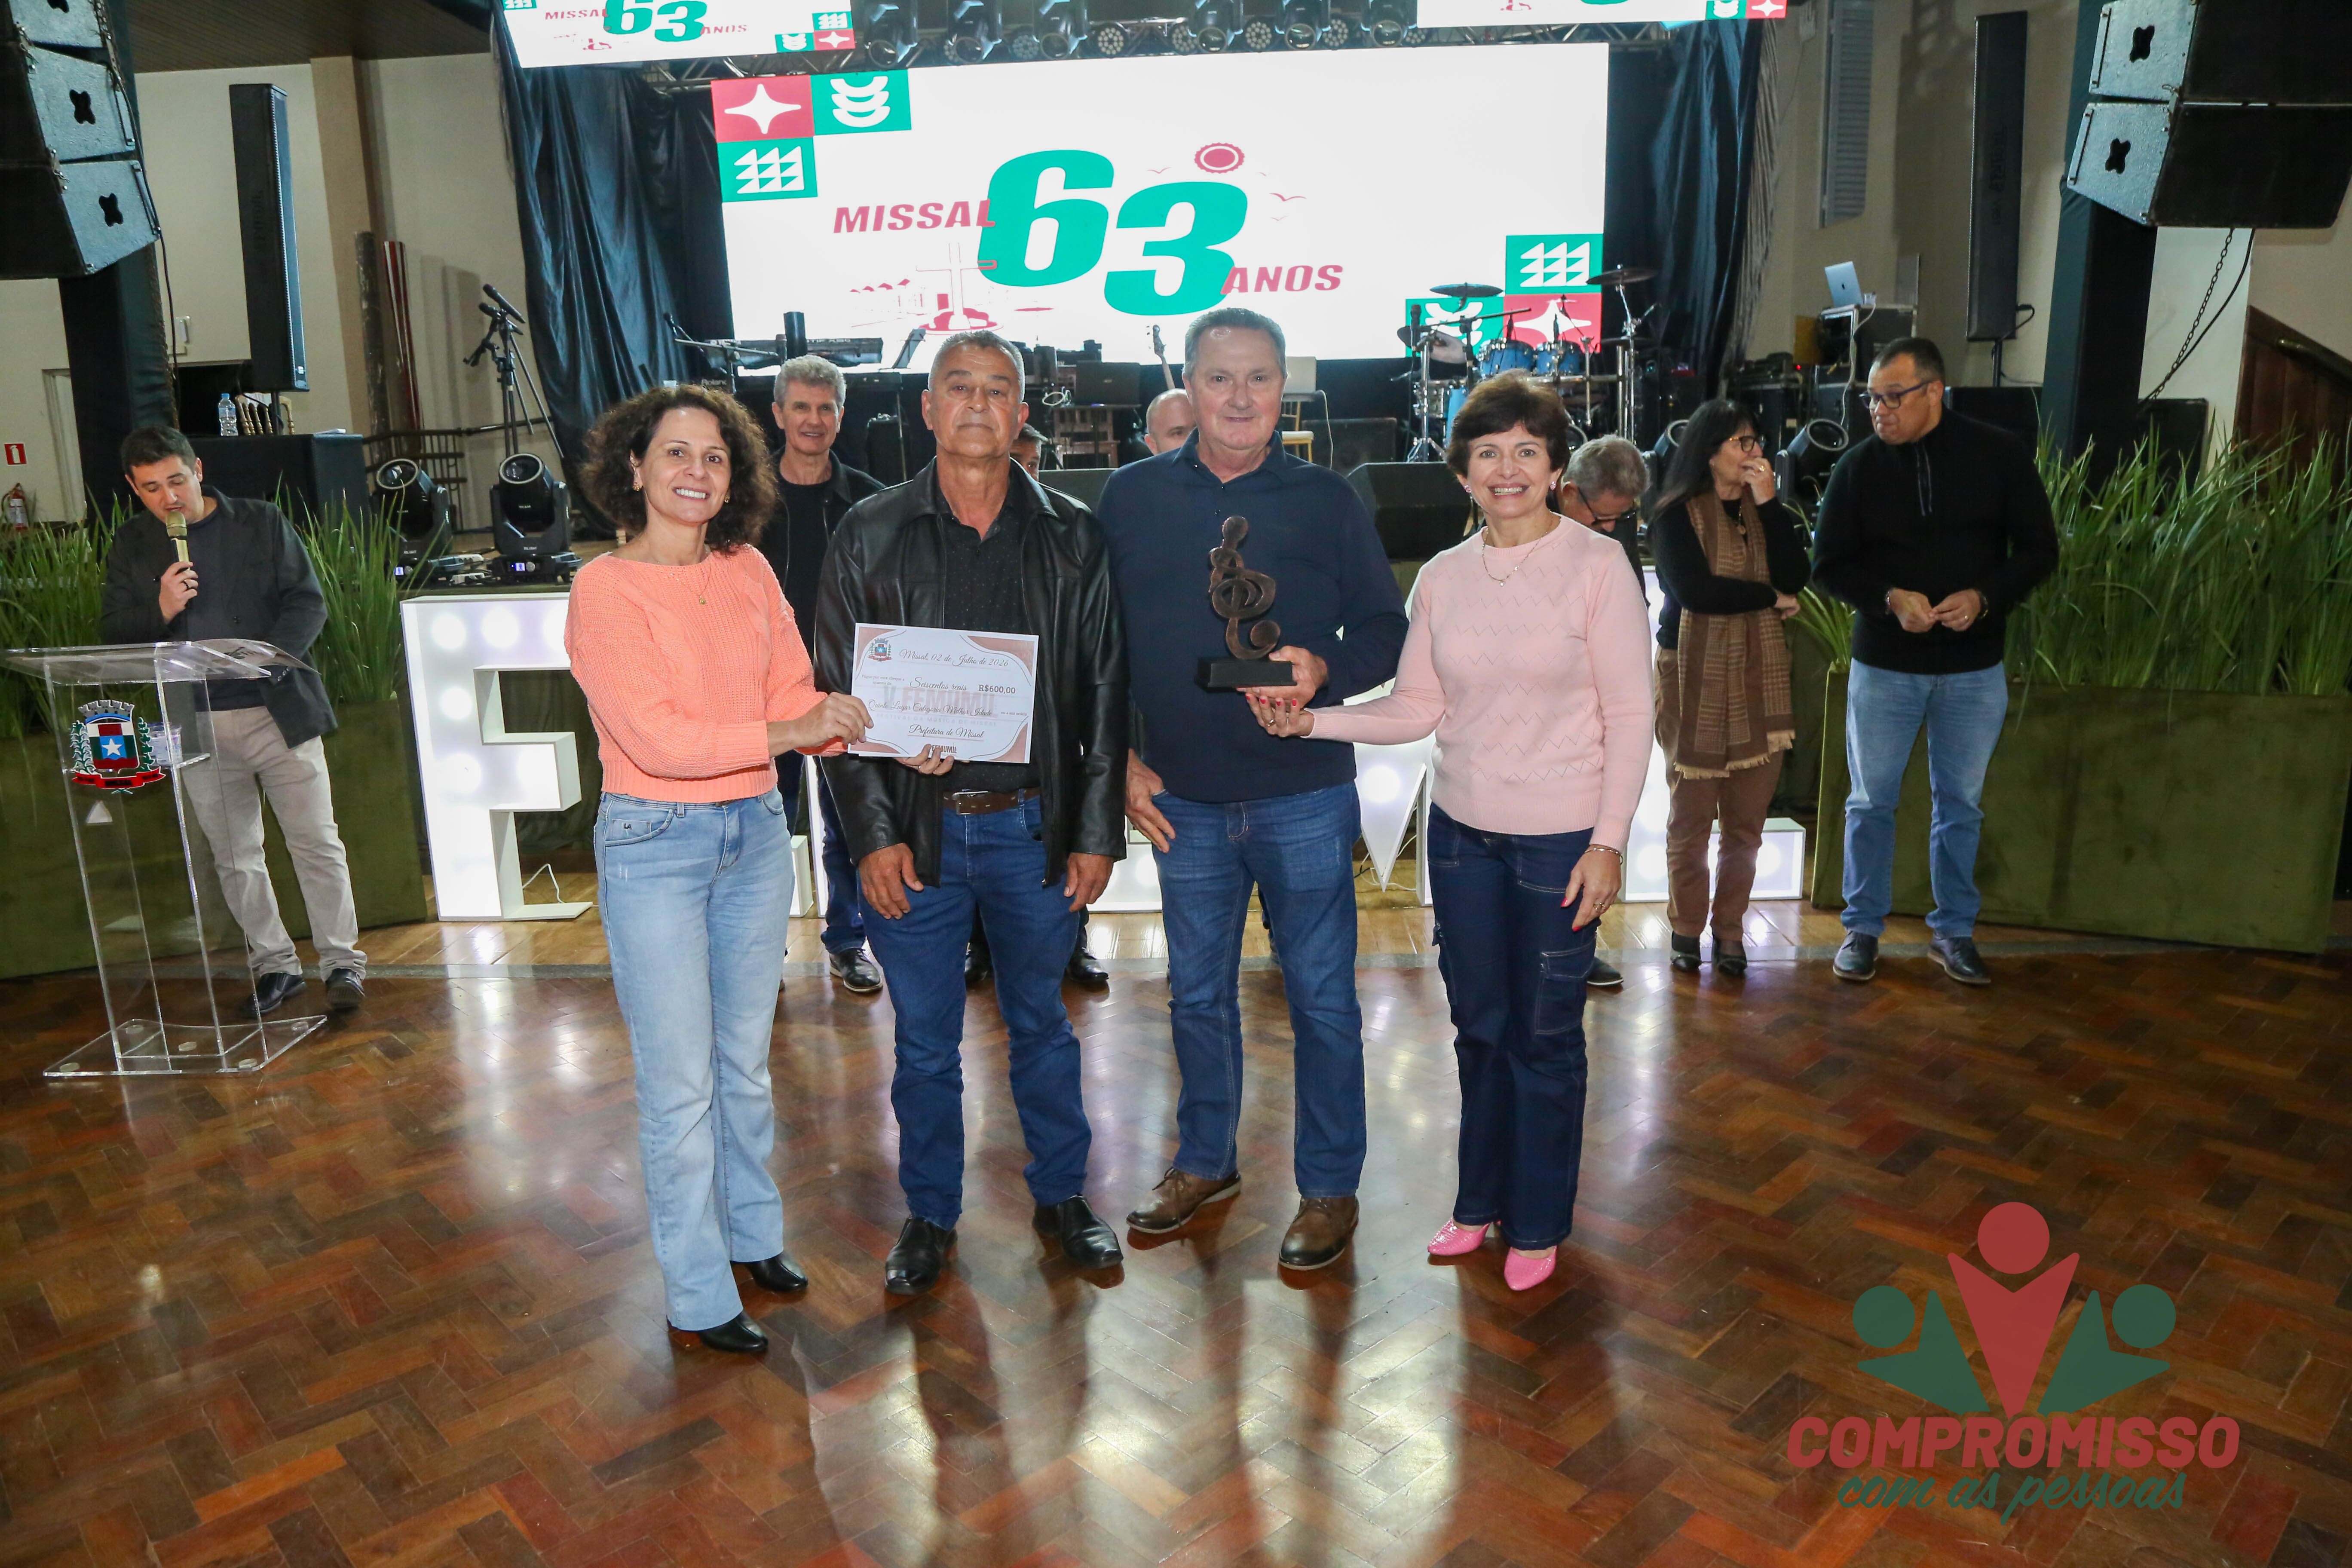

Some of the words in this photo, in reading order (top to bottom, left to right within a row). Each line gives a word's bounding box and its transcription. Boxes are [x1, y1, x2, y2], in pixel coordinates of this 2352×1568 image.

[545, 8, 609, 20] MISSAL
[603, 0, 707, 42] 63
[700, 24, 747, 35] ANOS
[833, 198, 996, 233] MISSAL
[977, 150, 1248, 316] 63
[1220, 264, 1343, 295] ANOS
[899, 649, 928, 660] Missal,
[931, 653, 942, 662] 02
[952, 654, 977, 666] Julho
[988, 658, 1009, 667] 2026
[910, 677, 948, 689] Seiscentos
[978, 684, 1016, 694] R$600,00
[891, 700, 911, 712] Lugar
[913, 702, 942, 714] Categoria
[943, 704, 968, 716] Melhor
[970, 707, 992, 717] Idade
[909, 724, 944, 737] Prefeitura
[955, 727, 985, 738] Missal
